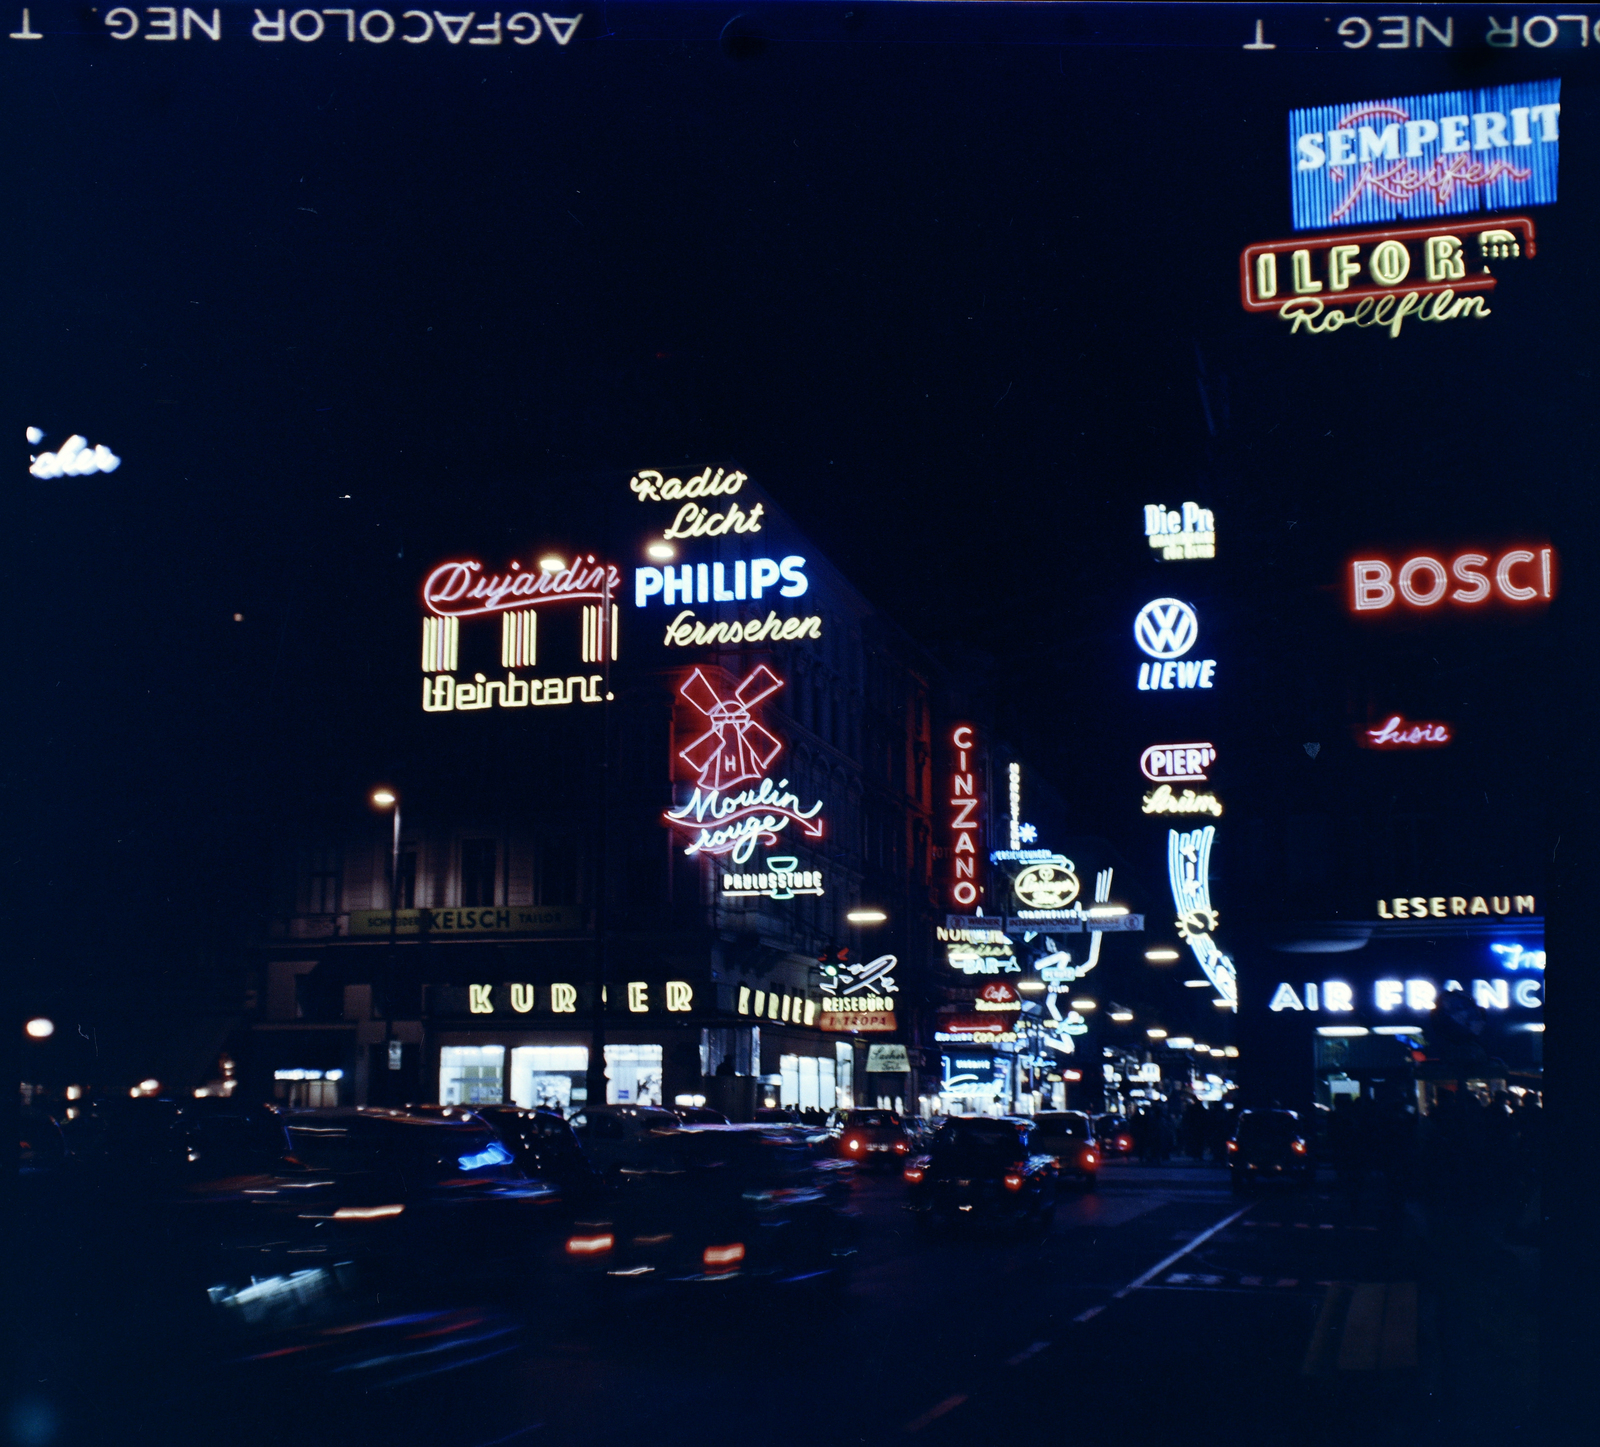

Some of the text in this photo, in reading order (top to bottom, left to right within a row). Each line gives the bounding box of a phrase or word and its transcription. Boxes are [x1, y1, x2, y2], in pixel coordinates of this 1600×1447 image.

[10, 8, 43, 40] T
[252, 9, 582, 45] AGFACOLOR
[1243, 19, 1276, 50] T
[1298, 103, 1561, 171] SEMPERIT
[1279, 288, 1491, 338] Rollfilm
[630, 466, 748, 502] Radio
[663, 503, 764, 540] Licht
[1144, 504, 1181, 535] Die
[424, 555, 621, 617] Dujardin
[635, 555, 809, 608] PHILIPS
[1138, 601, 1195, 656] VW
[1137, 659, 1217, 690] LIEWE
[667, 777, 823, 823] Moulin
[951, 726, 978, 905] CINZANO
[684, 815, 790, 865] rouge
[427, 910, 510, 930] KELSCH
[519, 911, 562, 924] TAILOR
[1378, 894, 1535, 919] LESERAUM
[737, 985, 816, 1026] KURIER
[822, 992, 895, 1013] REISEBÜRO
[1268, 979, 1354, 1012] AIR
[829, 1015, 887, 1026] ITROPA
